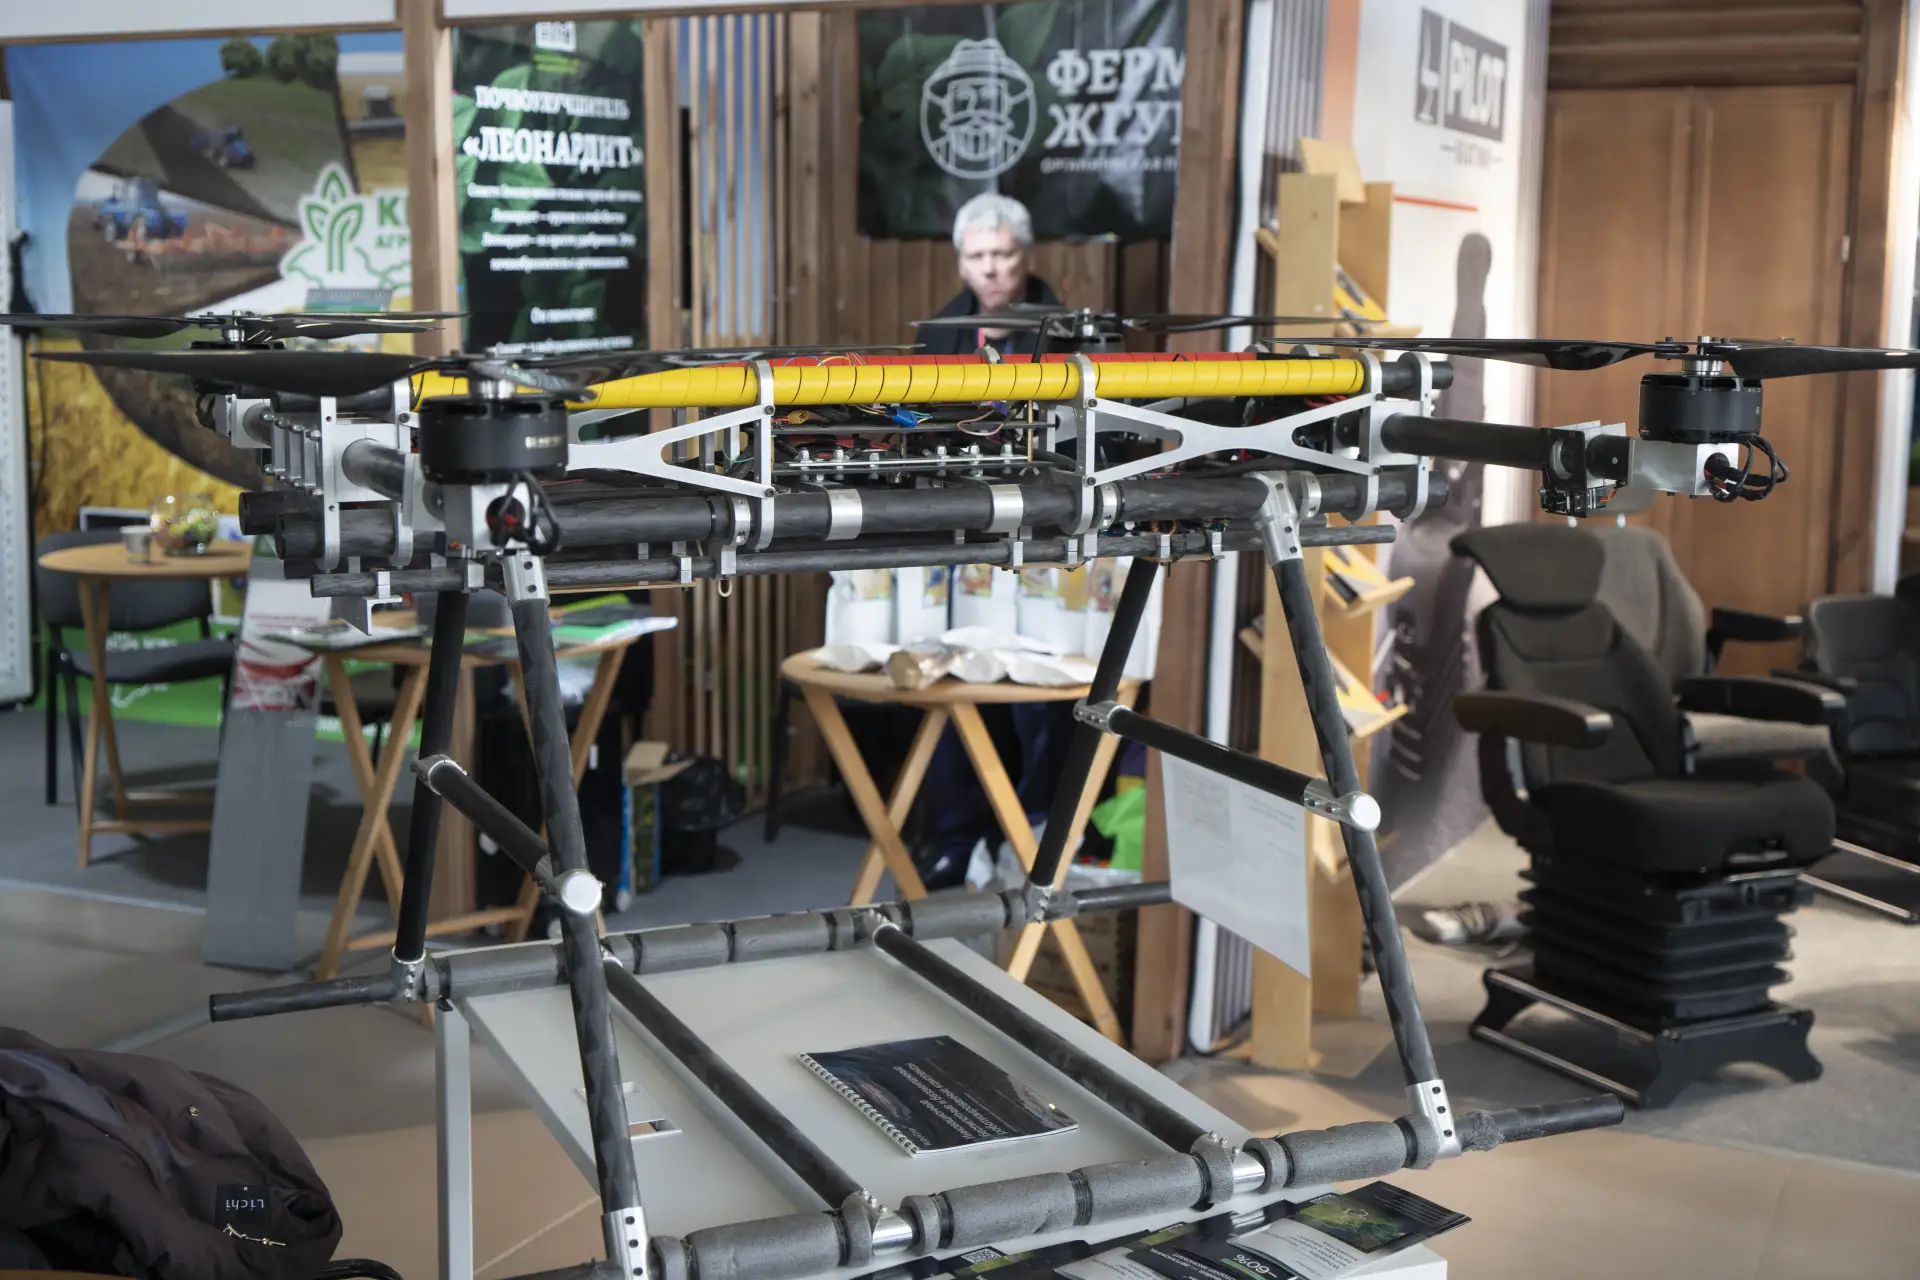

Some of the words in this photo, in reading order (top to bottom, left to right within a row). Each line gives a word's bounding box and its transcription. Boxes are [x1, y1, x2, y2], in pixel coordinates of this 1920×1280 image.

[1448, 39, 1505, 129] PILOT
[463, 126, 644, 175] «ЛЕОНАРДИТ»
[226, 1199, 264, 1211] Lichi
